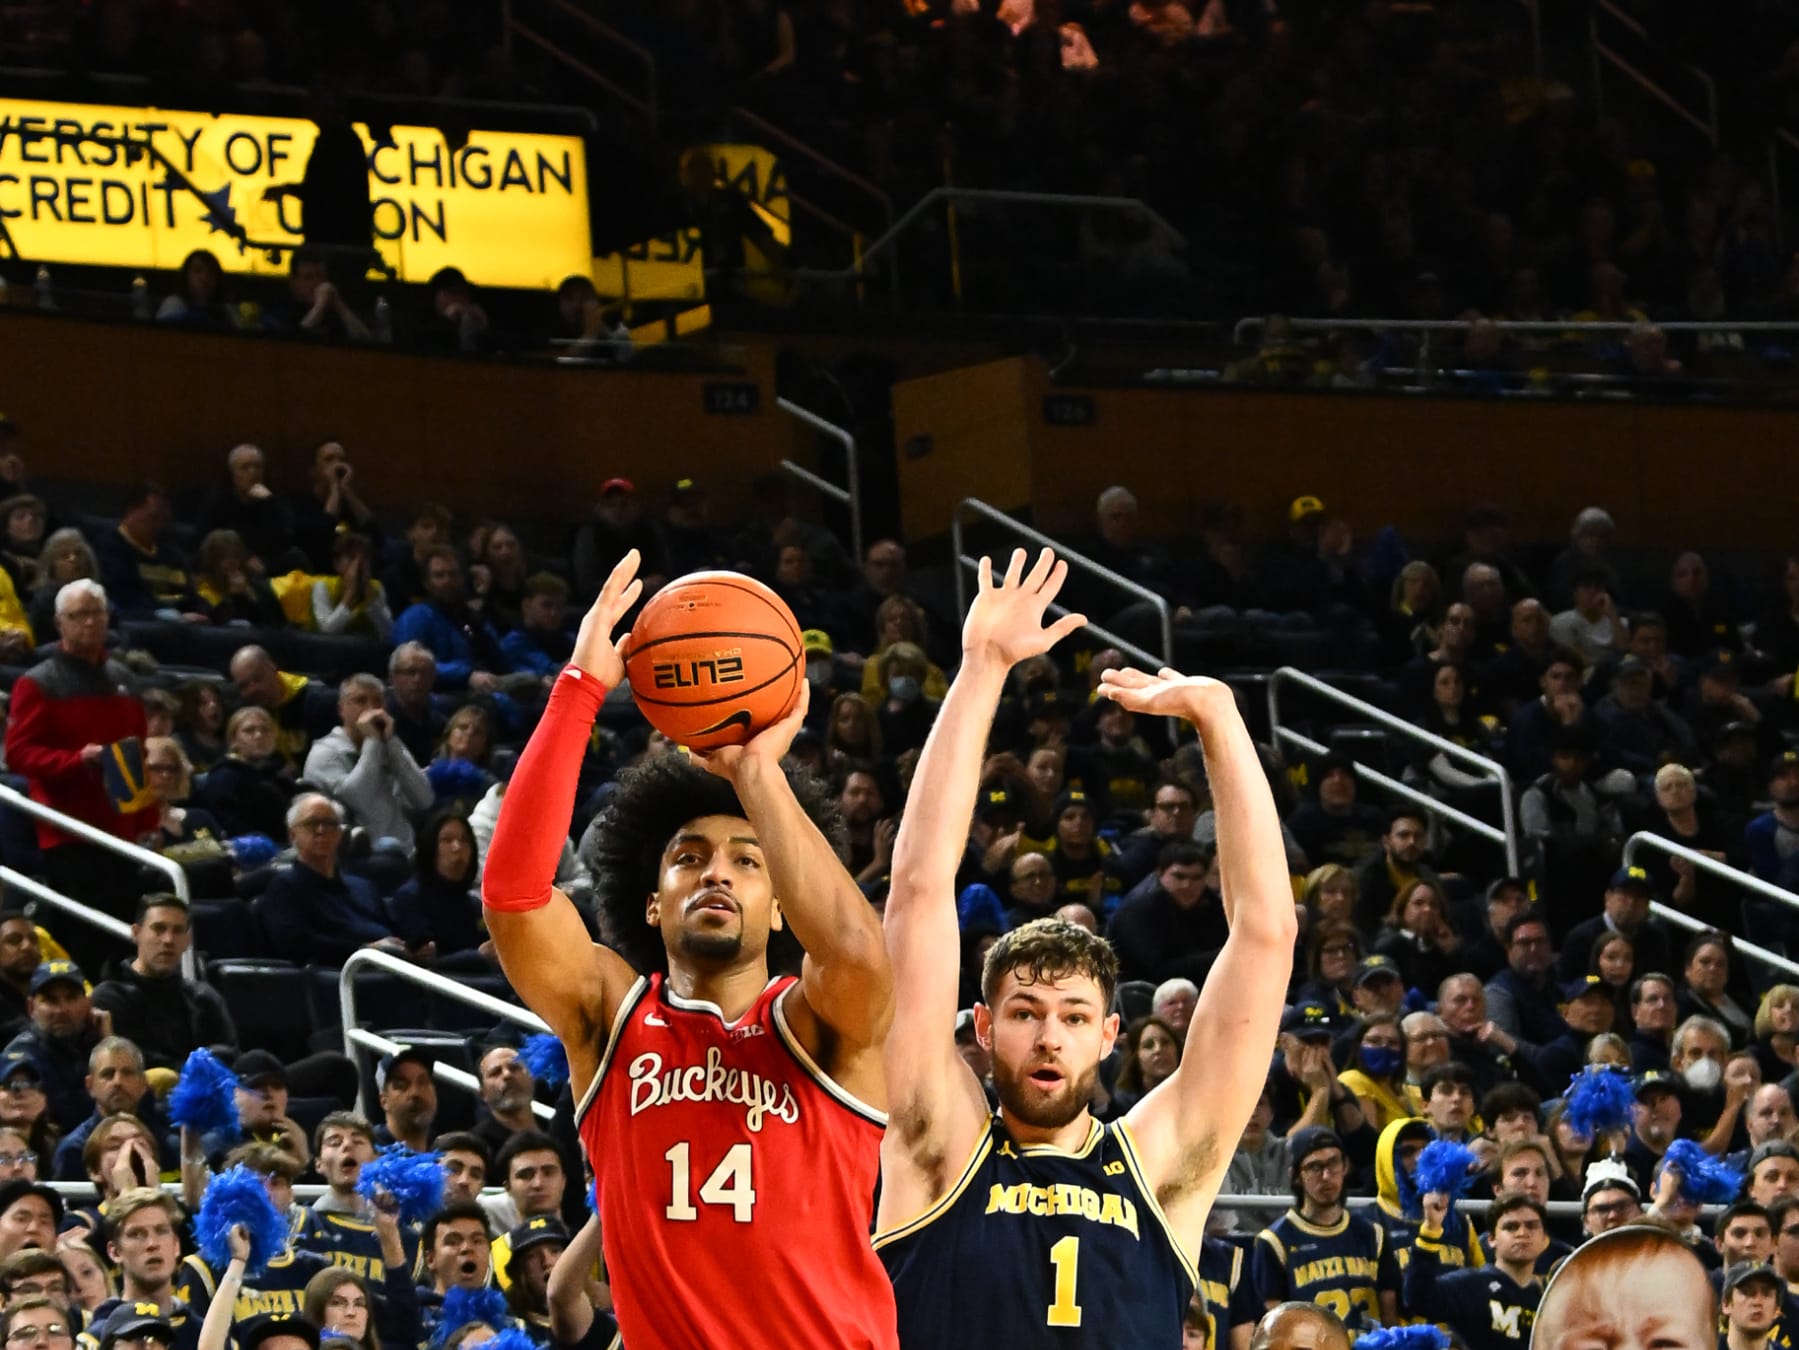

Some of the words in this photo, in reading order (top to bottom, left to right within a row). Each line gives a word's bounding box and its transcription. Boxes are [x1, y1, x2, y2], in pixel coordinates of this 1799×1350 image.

[0, 116, 202, 172] ERSITY
[225, 132, 293, 178] OF
[366, 140, 573, 194] CHIGAN
[0, 175, 189, 229] CREDIT
[274, 192, 447, 242] UON
[653, 657, 745, 689] ELITE
[628, 1046, 800, 1132] Buckeyes
[664, 1141, 757, 1222] 14
[1046, 1235, 1082, 1327] 1
